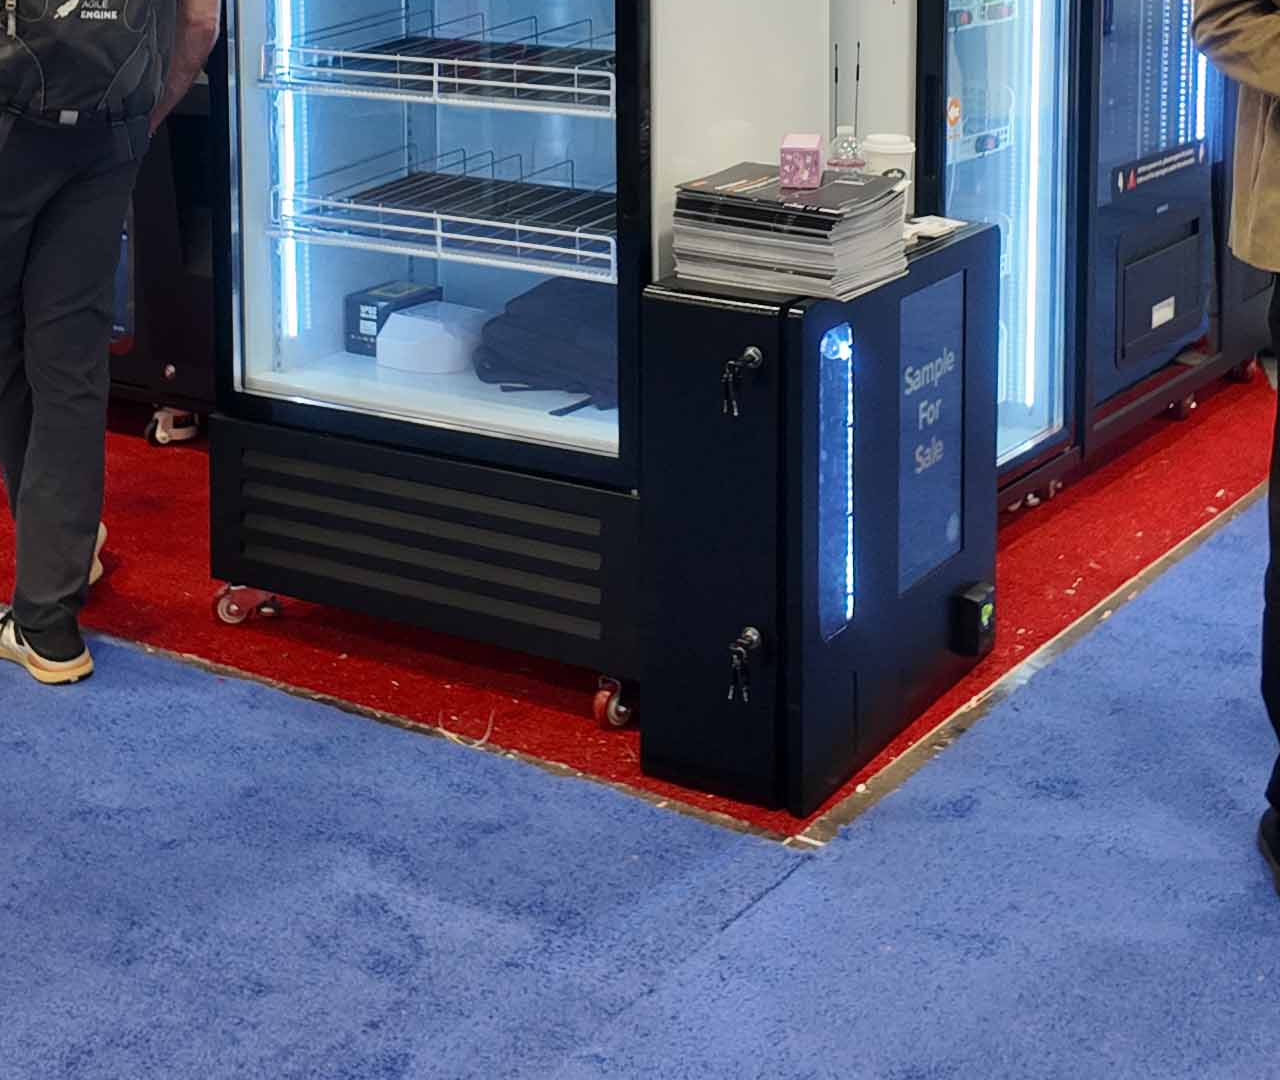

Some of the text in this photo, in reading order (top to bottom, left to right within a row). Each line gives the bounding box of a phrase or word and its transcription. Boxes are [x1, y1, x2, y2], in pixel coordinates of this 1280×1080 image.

[80, 10, 118, 20] ENGINE
[903, 346, 955, 396] Sample
[917, 396, 943, 431] For
[913, 436, 945, 474] Sale
